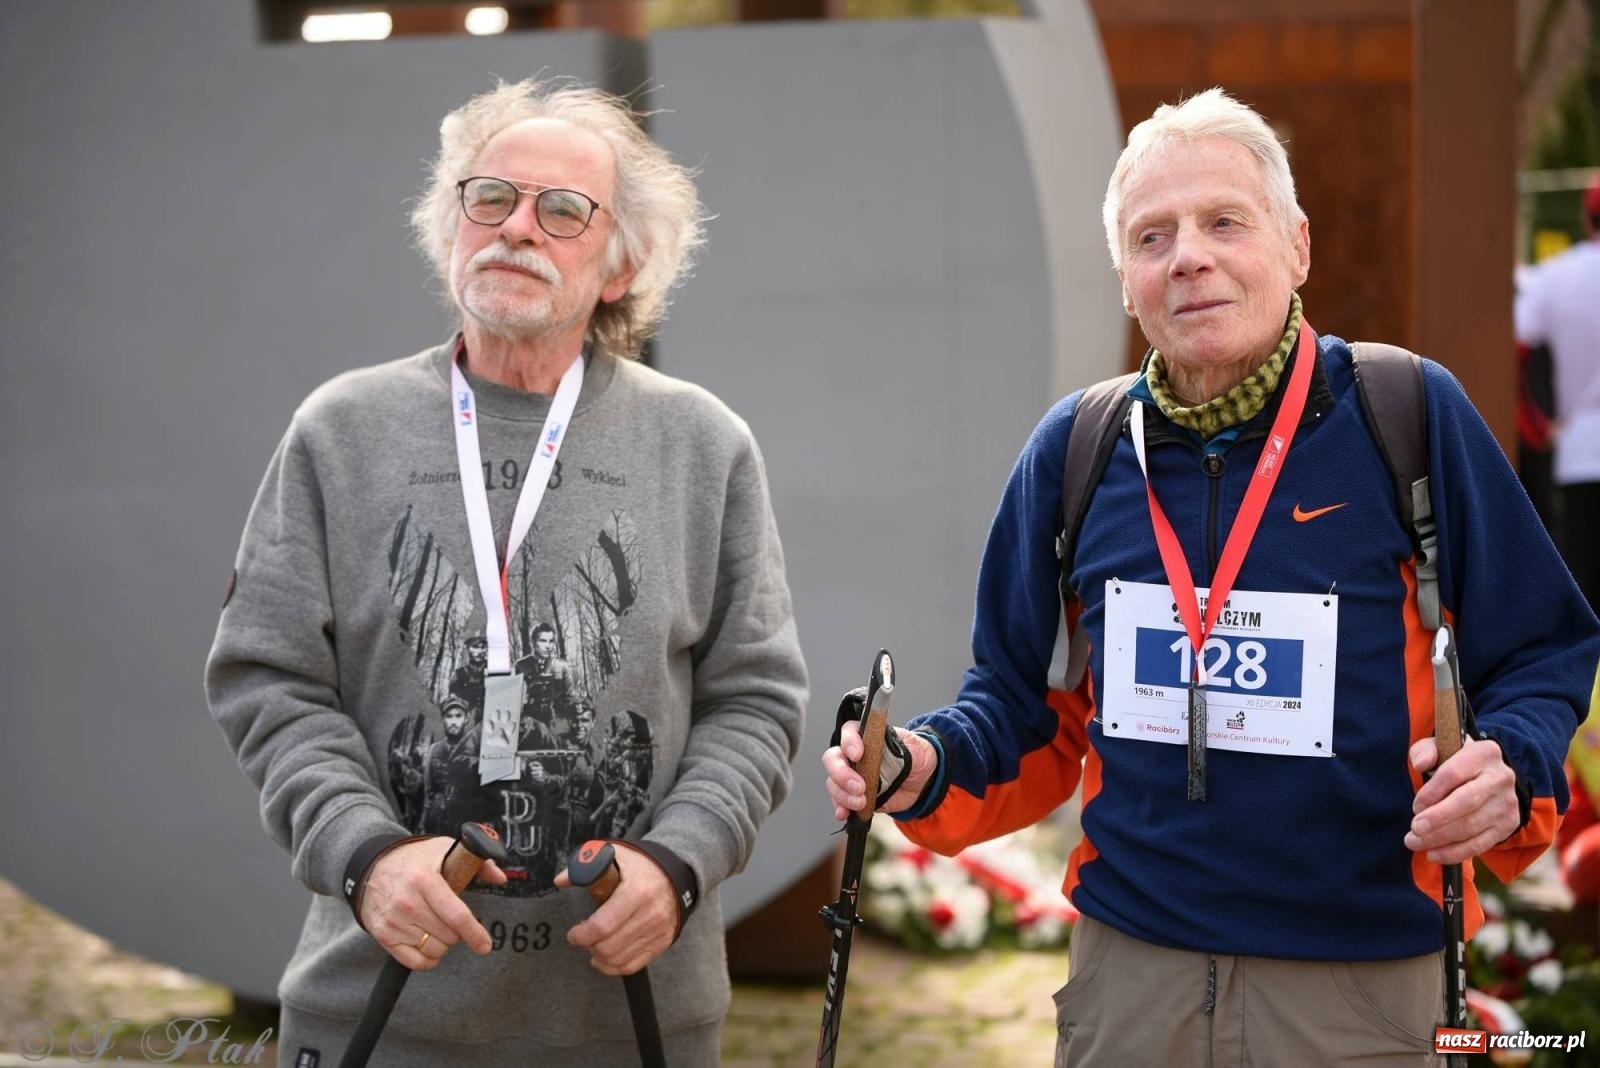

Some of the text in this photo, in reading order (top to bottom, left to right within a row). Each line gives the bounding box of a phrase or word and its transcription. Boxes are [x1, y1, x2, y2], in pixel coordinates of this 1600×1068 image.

[482, 459, 563, 491] 193
[582, 467, 626, 488] Wyklęci
[1169, 635, 1267, 690] 128
[1134, 687, 1154, 697] 1963
[1256, 699, 1281, 708] EDYCJA
[1283, 700, 1301, 710] 2024
[1146, 723, 1180, 735] Racibórz
[1206, 731, 1291, 746] orskie Centrum Kultury
[478, 919, 551, 953] 963
